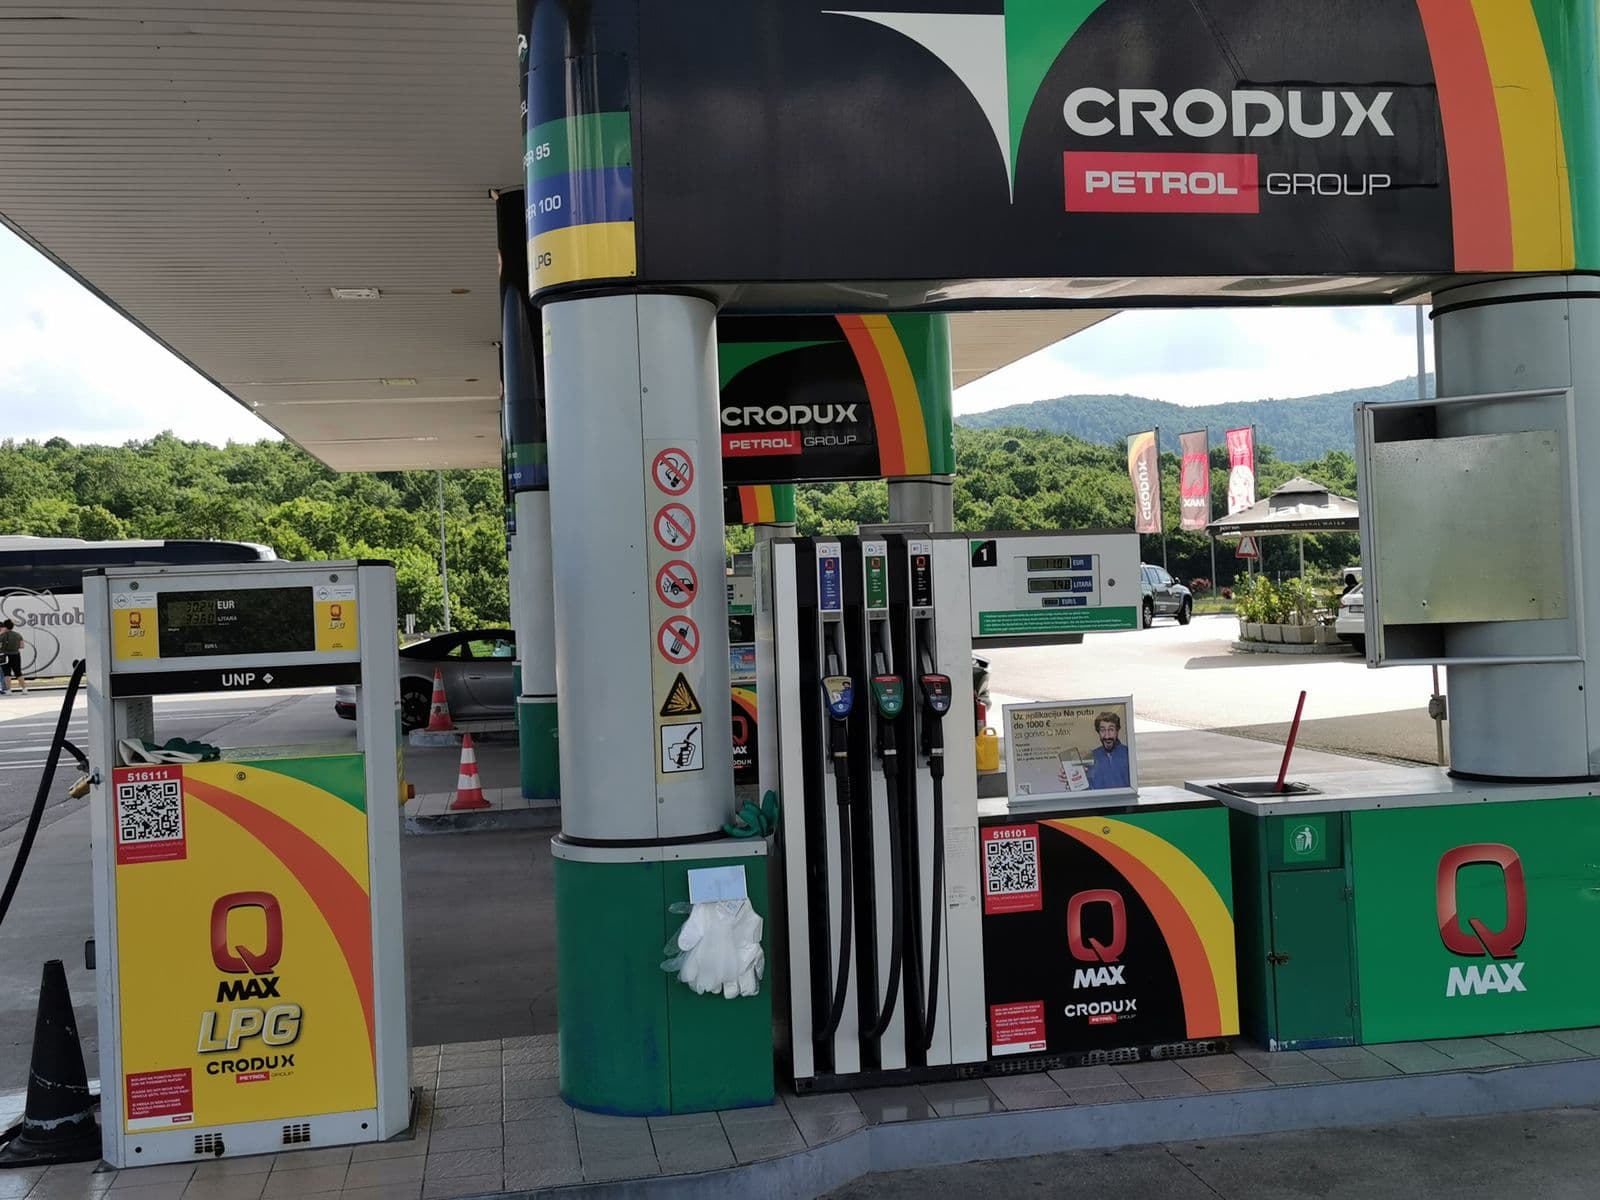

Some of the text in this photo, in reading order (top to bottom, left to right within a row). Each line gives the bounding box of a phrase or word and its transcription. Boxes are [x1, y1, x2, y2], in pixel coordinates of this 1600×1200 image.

[1063, 87, 1394, 139] CRODUX
[536, 142, 550, 161] 95
[1085, 170, 1391, 196] PETROL GROUP
[538, 195, 561, 214] 100
[535, 252, 552, 270] LPG
[721, 403, 858, 427] CRODUX
[729, 434, 857, 450] PETROL GROUP
[980, 548, 988, 562] 1
[217, 600, 235, 610] EUR
[222, 672, 256, 687] UNP
[1063, 709, 1075, 717] Na
[1013, 721, 1024, 730] do
[1026, 720, 1044, 729] 1000
[127, 770, 168, 782] 516111
[992, 828, 1027, 839] 516101
[1436, 843, 1527, 960] Q
[210, 891, 283, 975] Q
[1066, 889, 1127, 963] Q
[1073, 965, 1126, 989] MAX
[1446, 962, 1527, 998] MAX
[216, 976, 281, 1003] MAX
[1064, 999, 1137, 1018] CRODUX
[197, 1003, 303, 1054] LPG
[206, 1054, 295, 1075] CRODUX
[239, 1073, 267, 1081] PETROL
